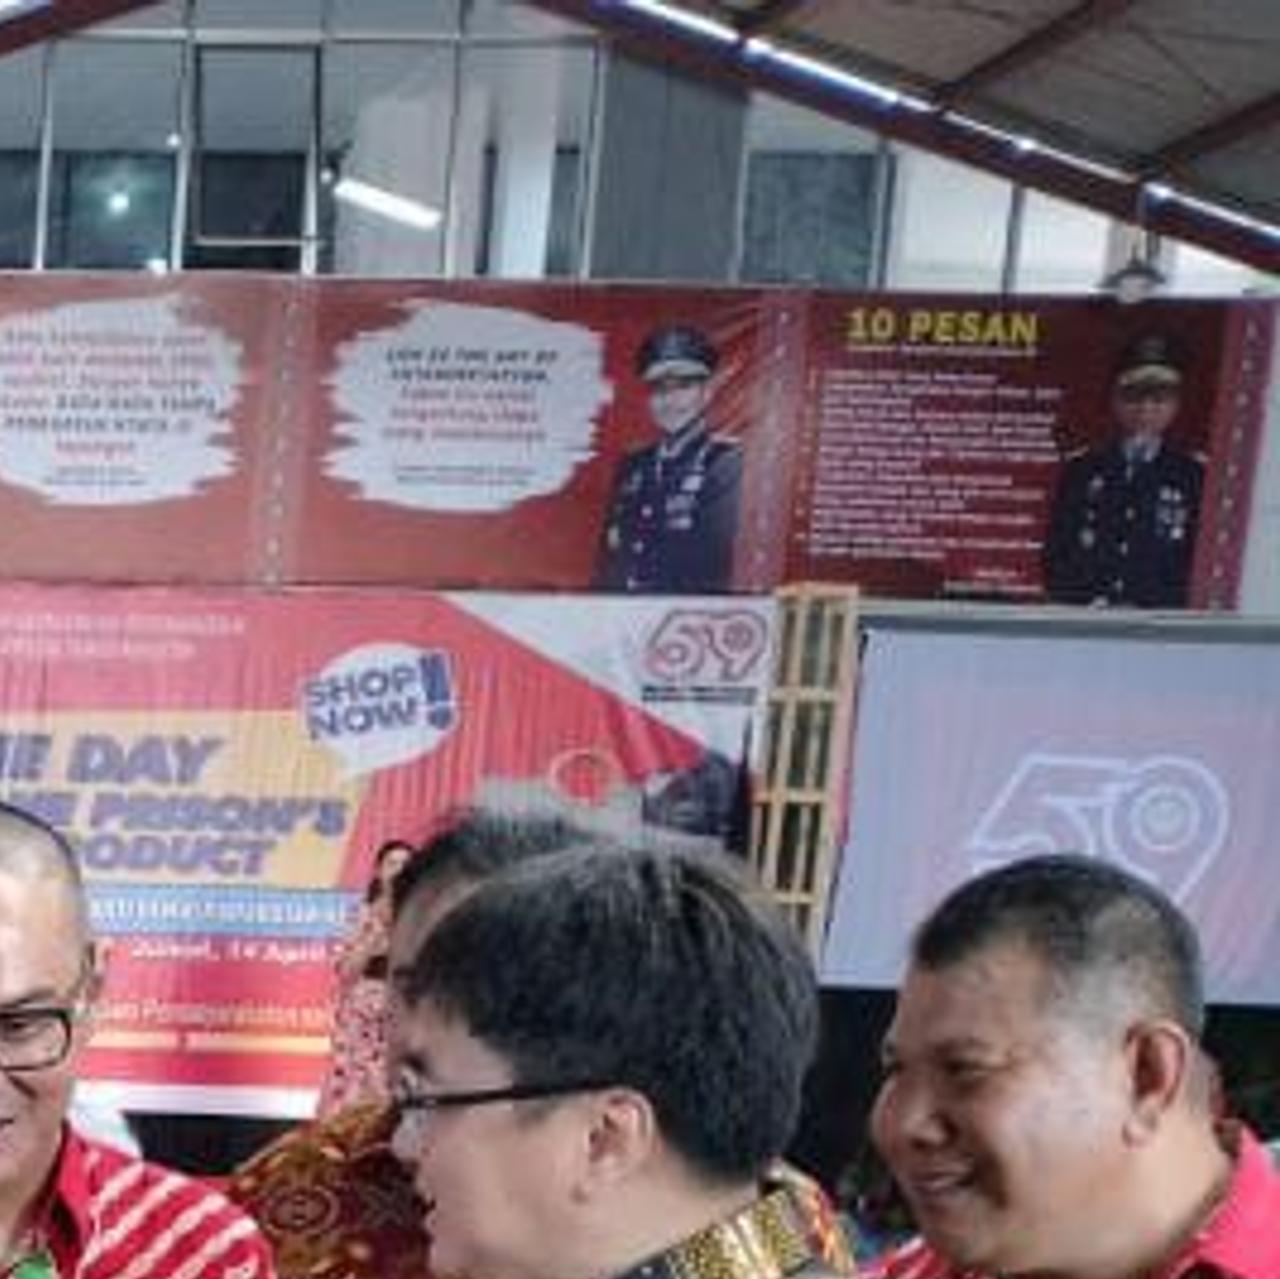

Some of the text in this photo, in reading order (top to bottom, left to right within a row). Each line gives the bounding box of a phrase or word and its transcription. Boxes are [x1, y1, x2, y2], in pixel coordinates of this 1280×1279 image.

[847, 307, 1039, 343] 10 PESAN
[646, 608, 770, 683] 59
[305, 664, 418, 709] SHOP
[307, 699, 419, 742] NOW
[66, 730, 226, 784] DAY
[84, 832, 279, 877] ODUCT
